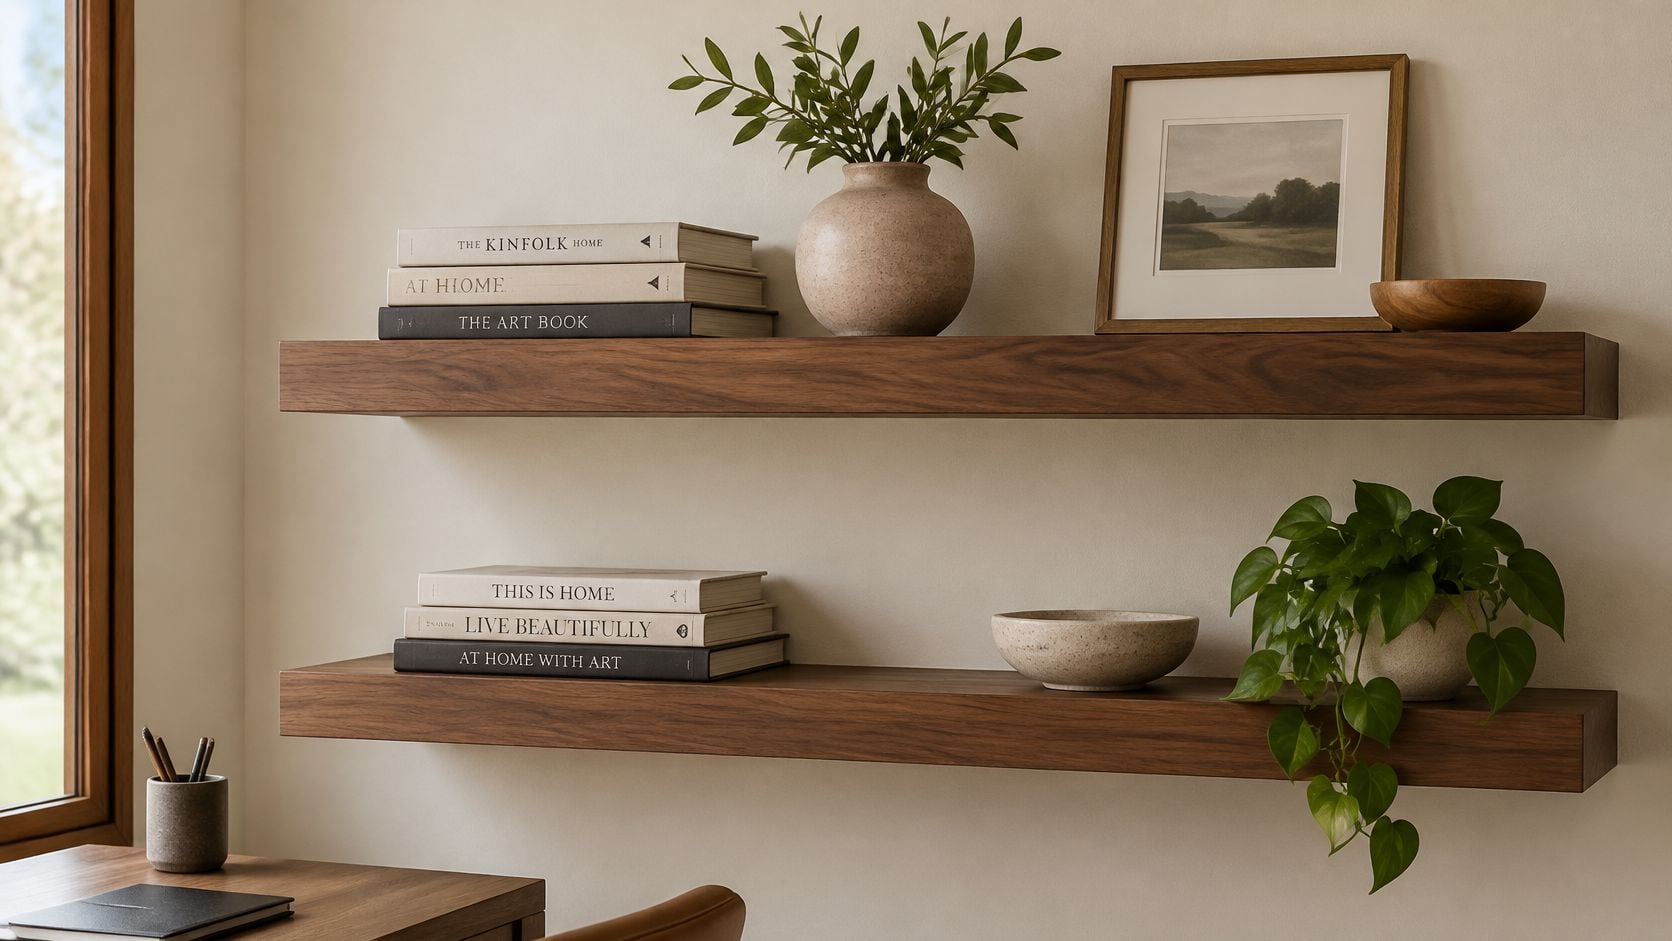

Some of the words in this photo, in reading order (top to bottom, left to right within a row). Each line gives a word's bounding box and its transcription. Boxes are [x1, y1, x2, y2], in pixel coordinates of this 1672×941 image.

[457, 240, 481, 250] THE
[485, 237, 568, 252] KINFOLK
[573, 239, 603, 248] HOME
[405, 279, 429, 294] AT
[458, 315, 491, 330] THE
[497, 315, 532, 330] ART
[538, 315, 589, 330] BOOK
[492, 583, 534, 599] THIS
[539, 585, 554, 600] IS
[560, 585, 616, 601] HOME
[465, 616, 510, 634] LIVE
[516, 617, 652, 639] BEAUTIFULLY
[459, 651, 480, 665] AT
[485, 652, 534, 667] HOME
[539, 653, 583, 669] WITH
[588, 656, 622, 670] ART
